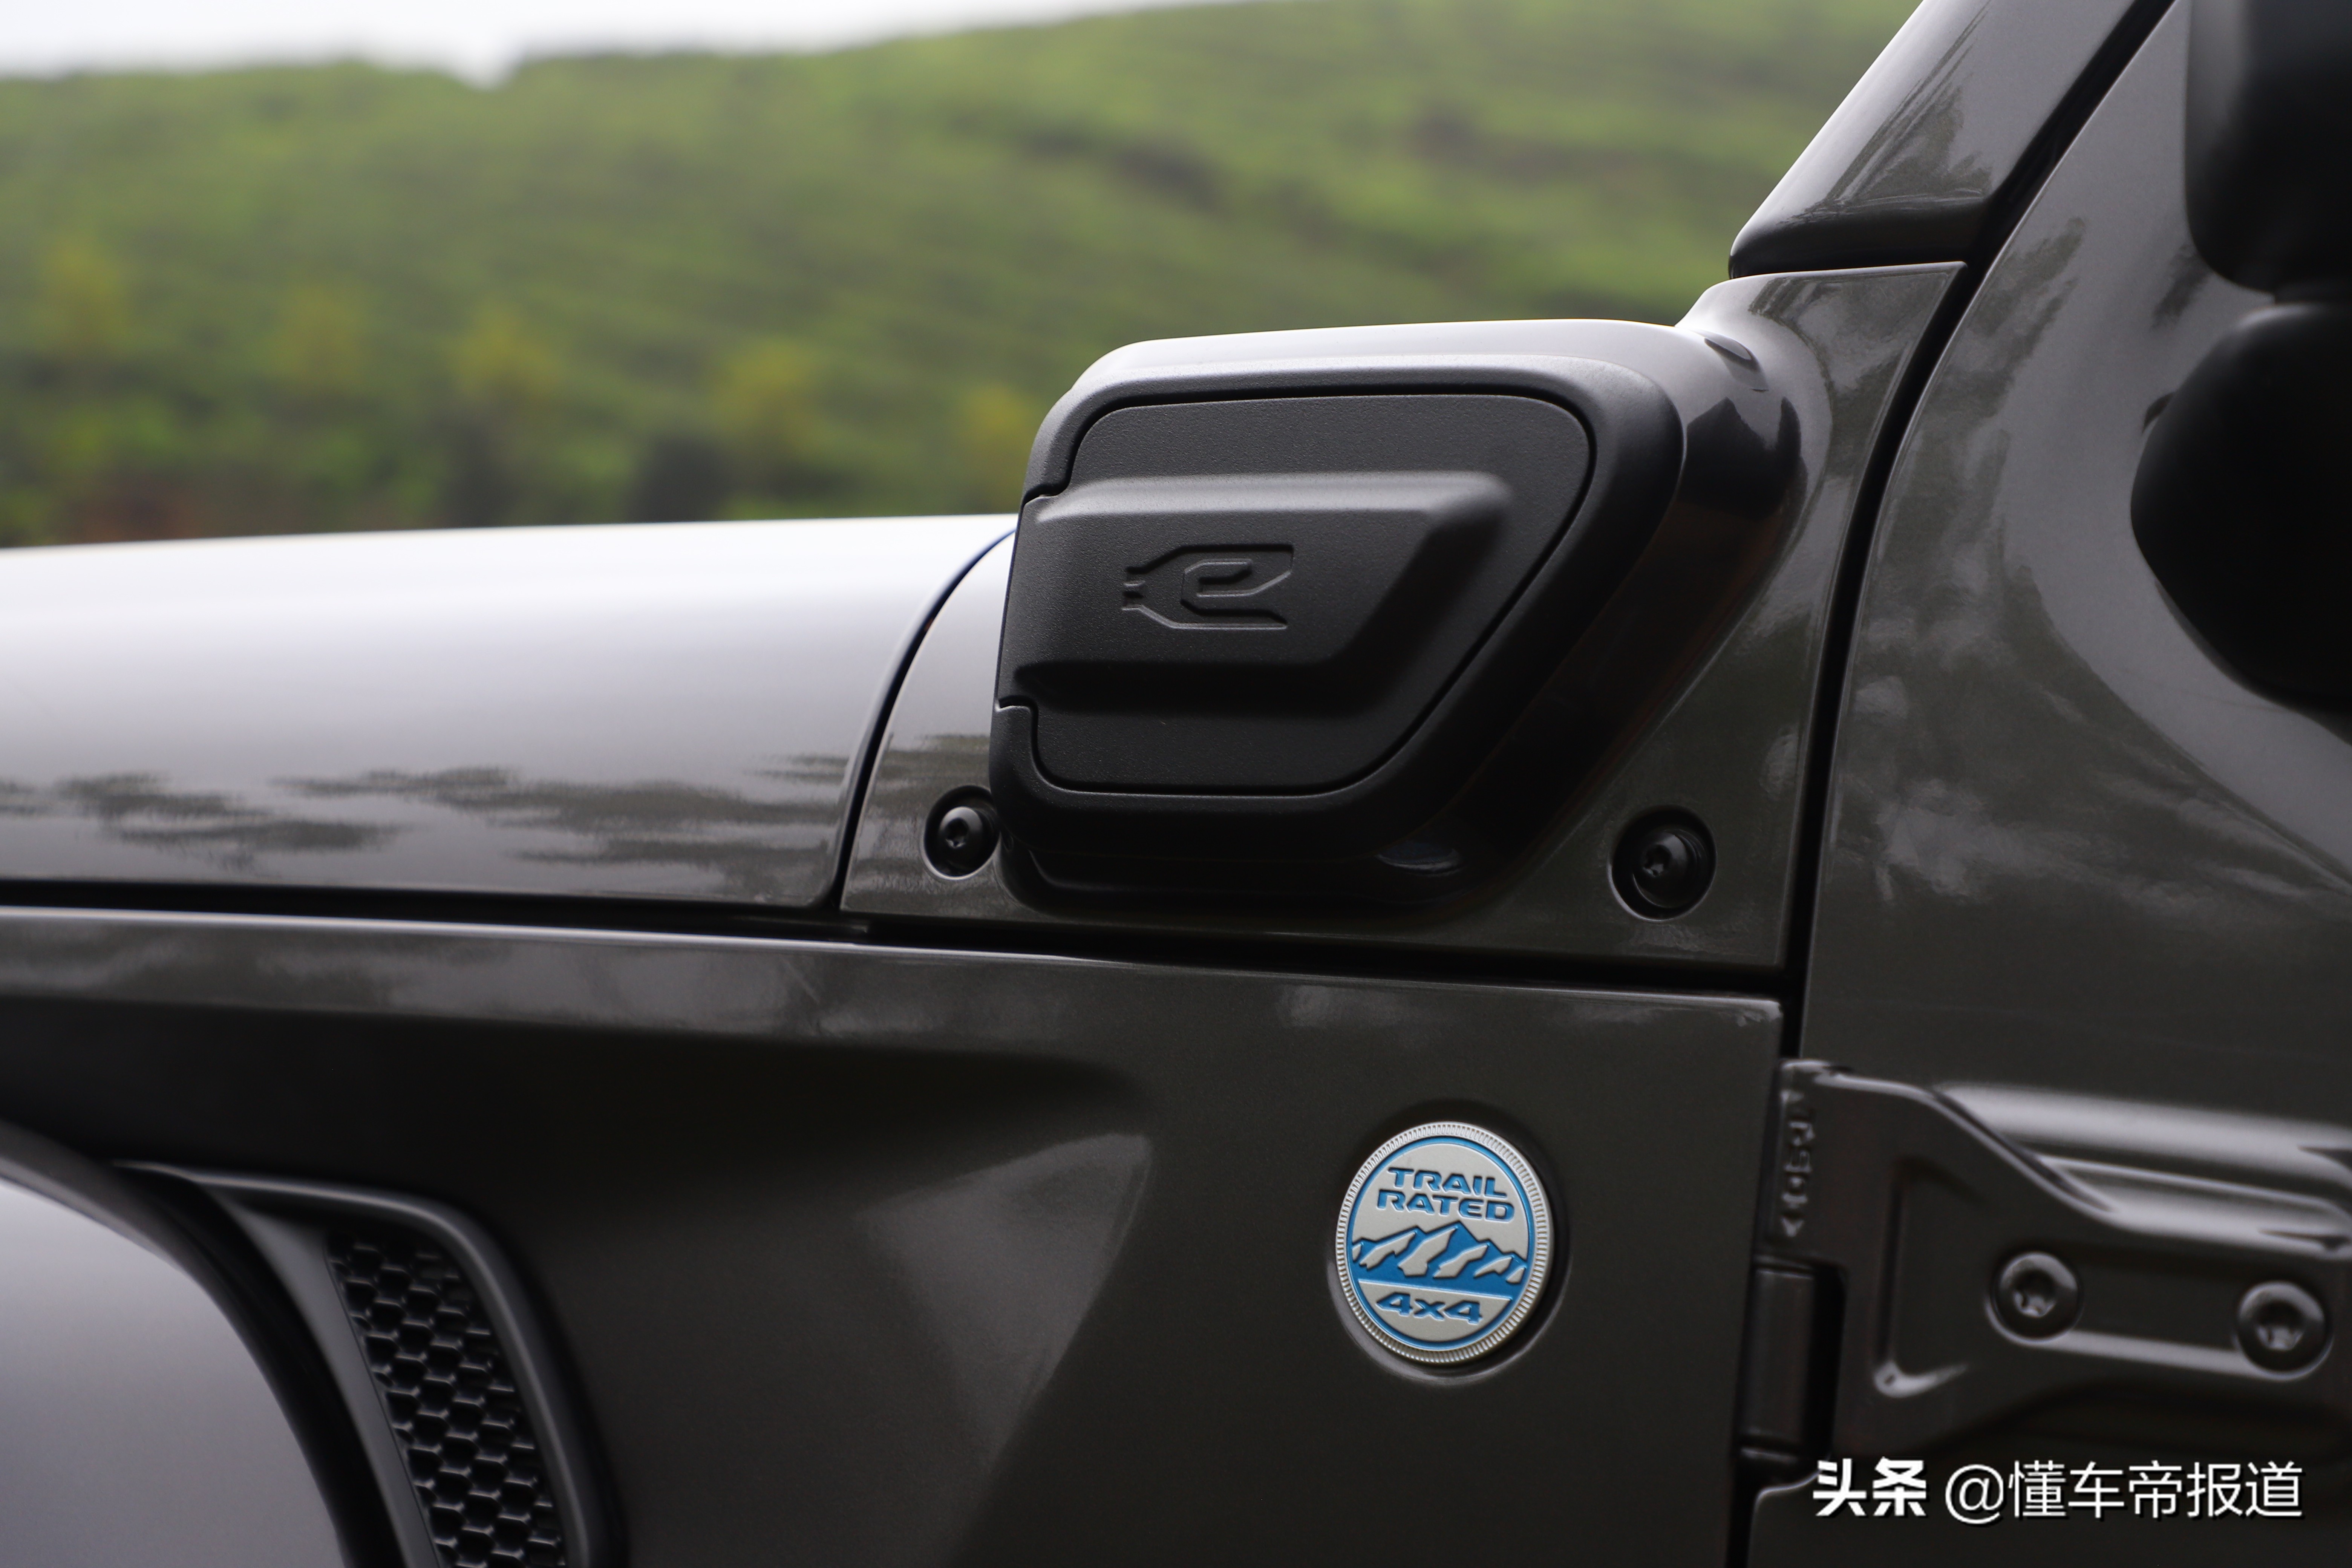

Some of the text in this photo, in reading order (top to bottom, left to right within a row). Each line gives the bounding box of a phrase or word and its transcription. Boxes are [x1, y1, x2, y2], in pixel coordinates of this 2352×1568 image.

[1388, 1168, 1507, 1198] TRAIL
[1378, 1190, 1514, 1222] RATED
[1376, 1292, 1483, 1324] 4x4
